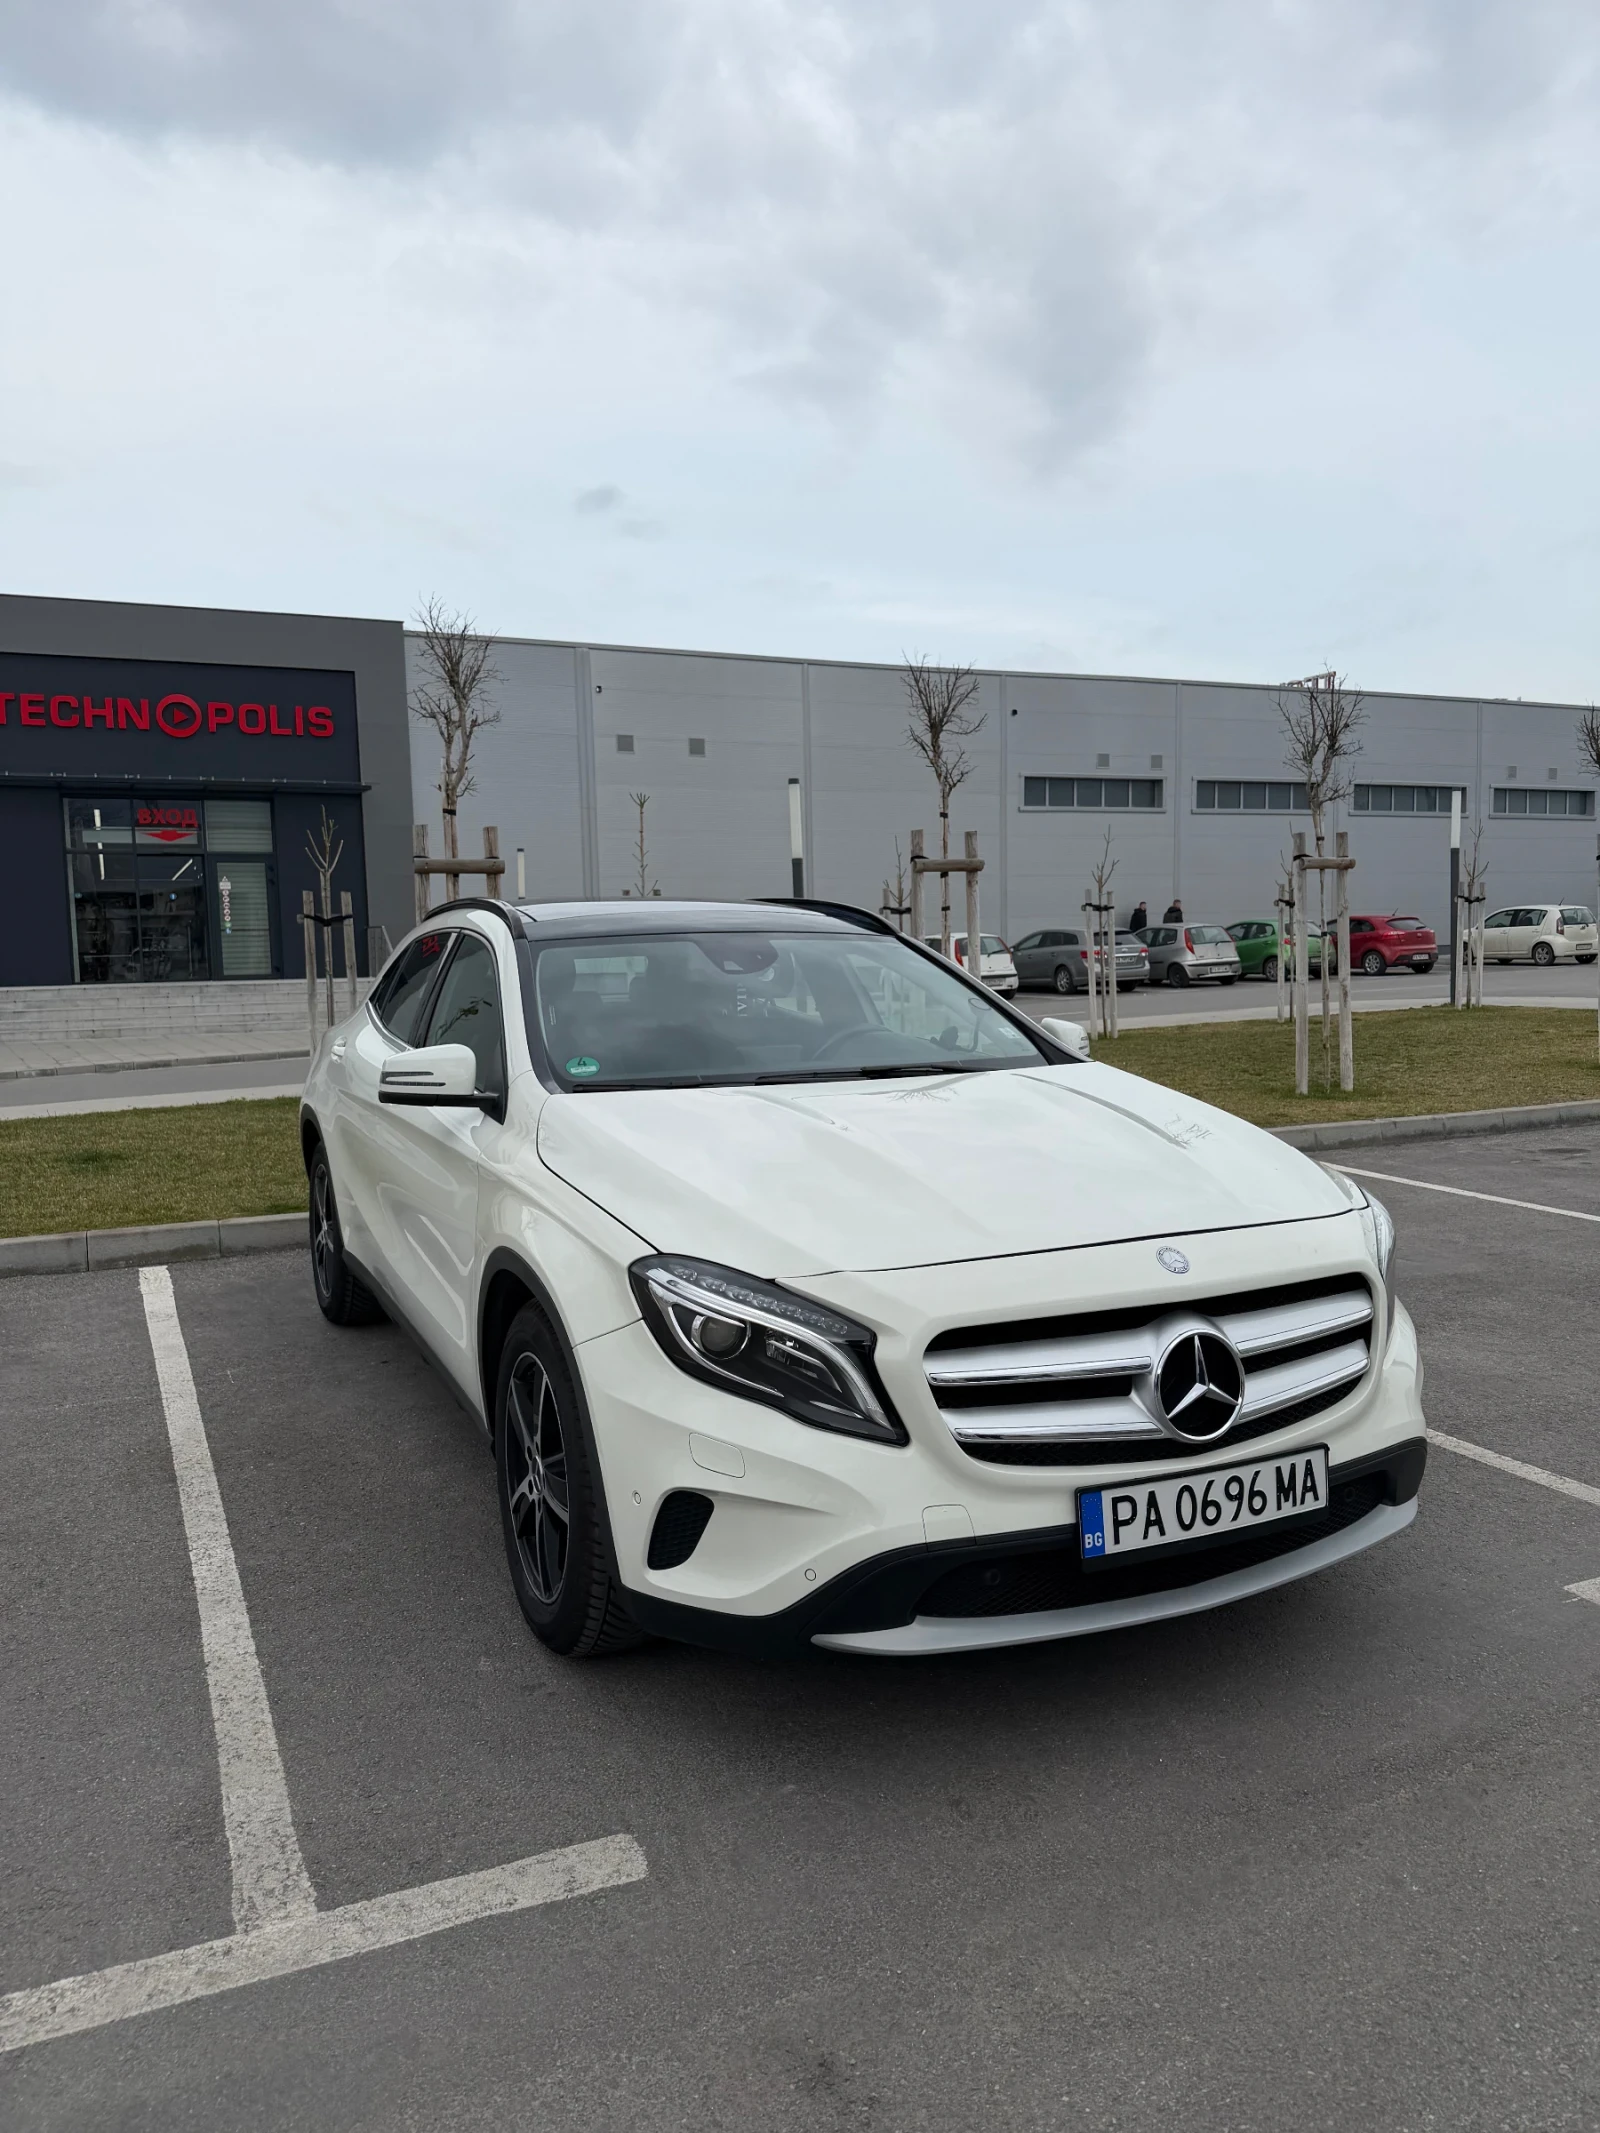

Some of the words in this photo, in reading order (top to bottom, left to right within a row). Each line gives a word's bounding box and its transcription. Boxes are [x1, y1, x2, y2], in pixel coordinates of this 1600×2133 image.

[0, 692, 335, 738] TECHNOPOLIS
[137, 808, 199, 828] ВХОД
[1084, 1532, 1103, 1549] BG
